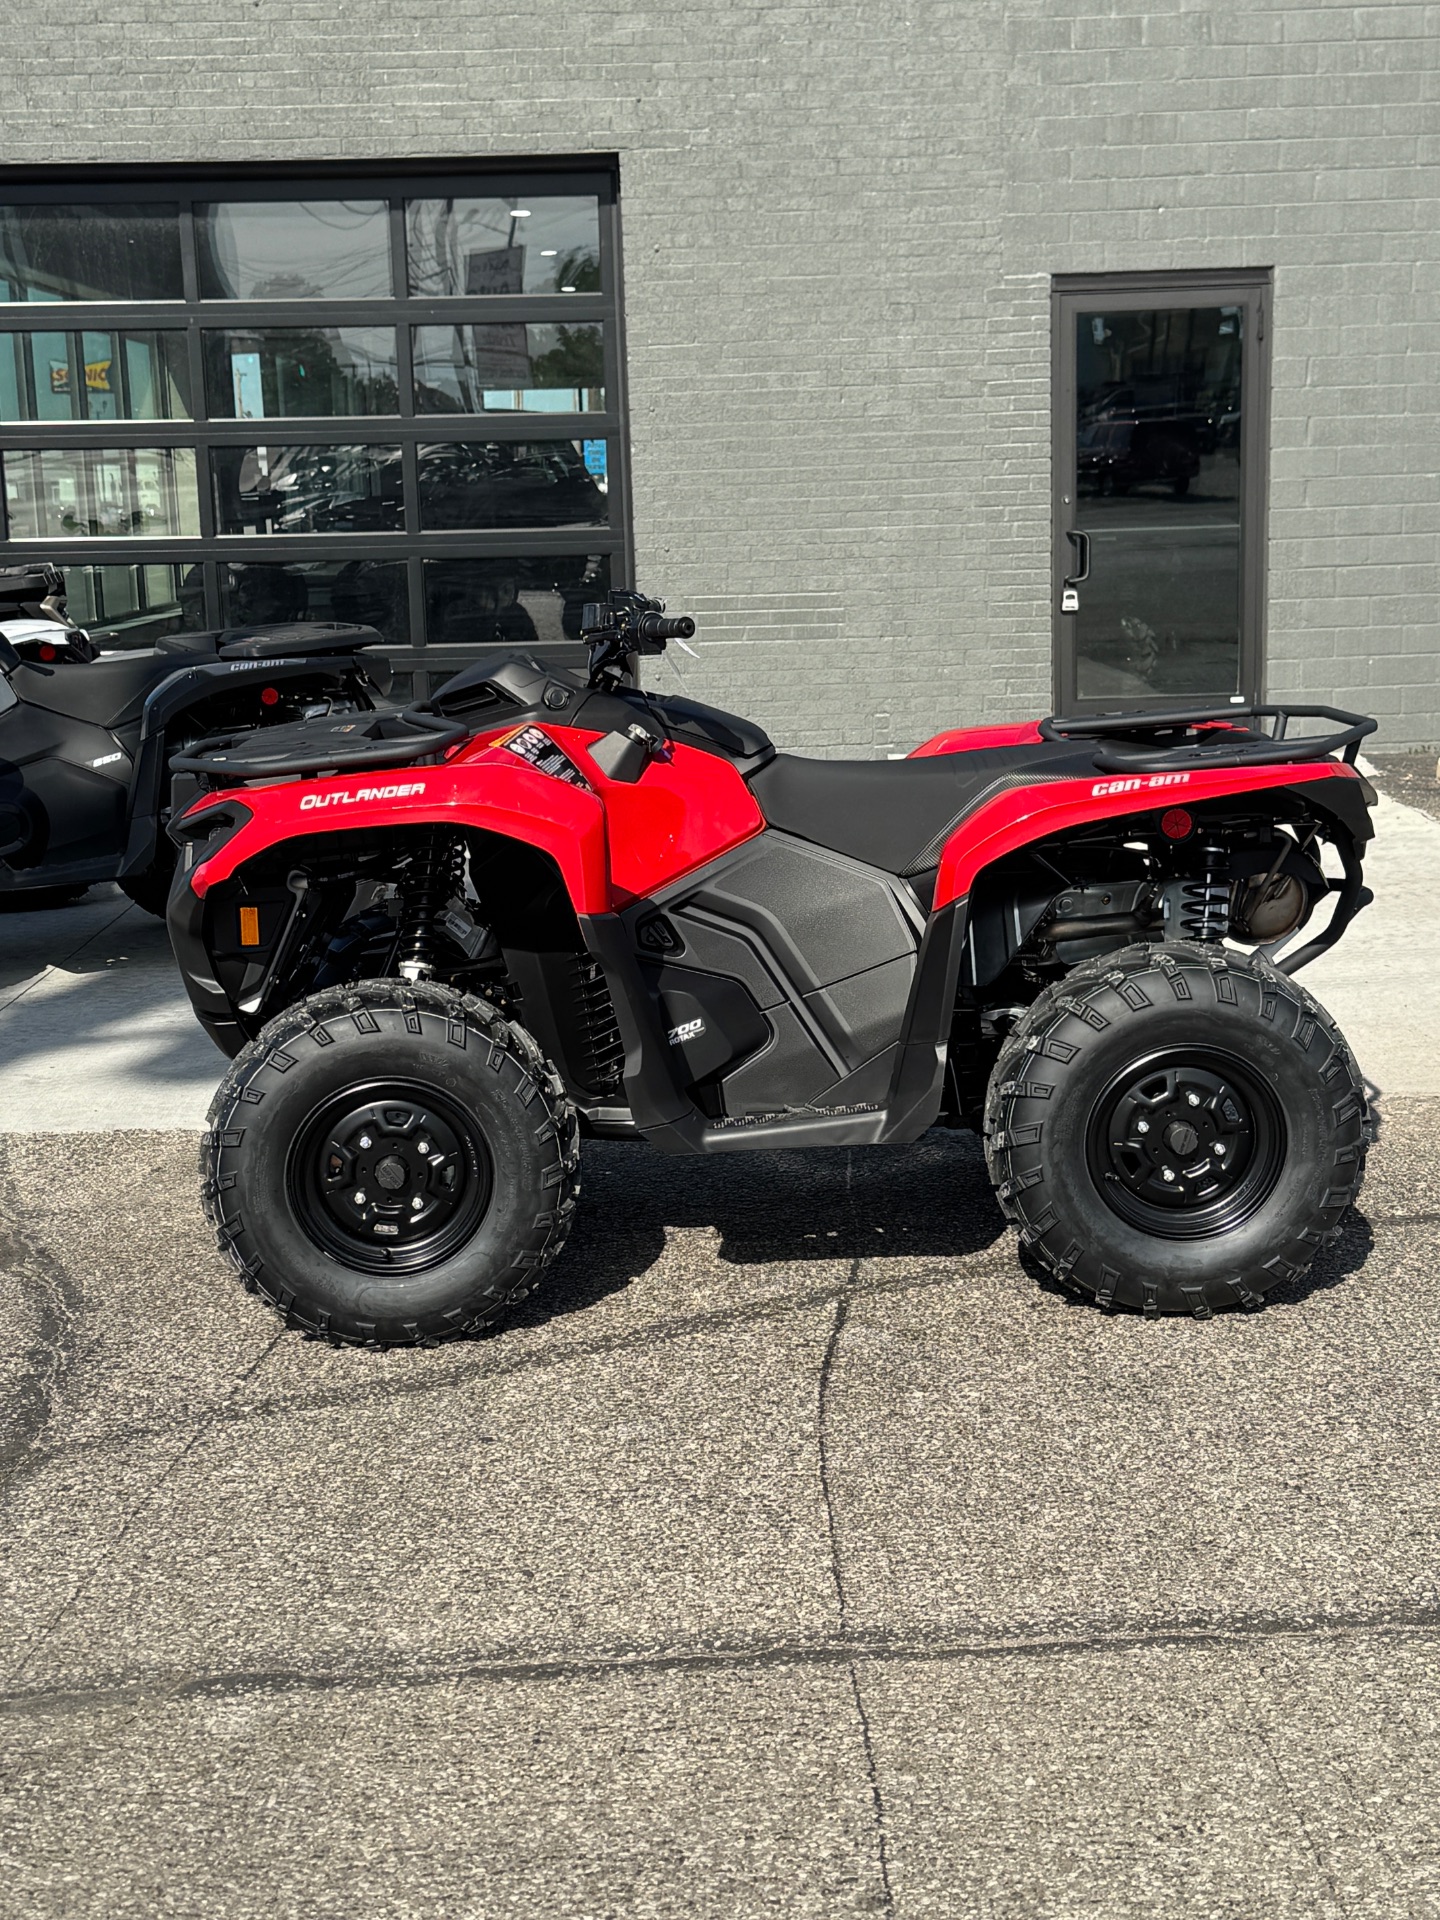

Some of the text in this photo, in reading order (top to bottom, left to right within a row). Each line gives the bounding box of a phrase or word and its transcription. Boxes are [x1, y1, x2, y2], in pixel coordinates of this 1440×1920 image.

[55, 367, 107, 383] SNIC
[1091, 773, 1190, 797] can-am
[299, 782, 426, 811] OUTLANDER
[667, 1018, 702, 1039] 700
[669, 1031, 696, 1046] ROTAX
